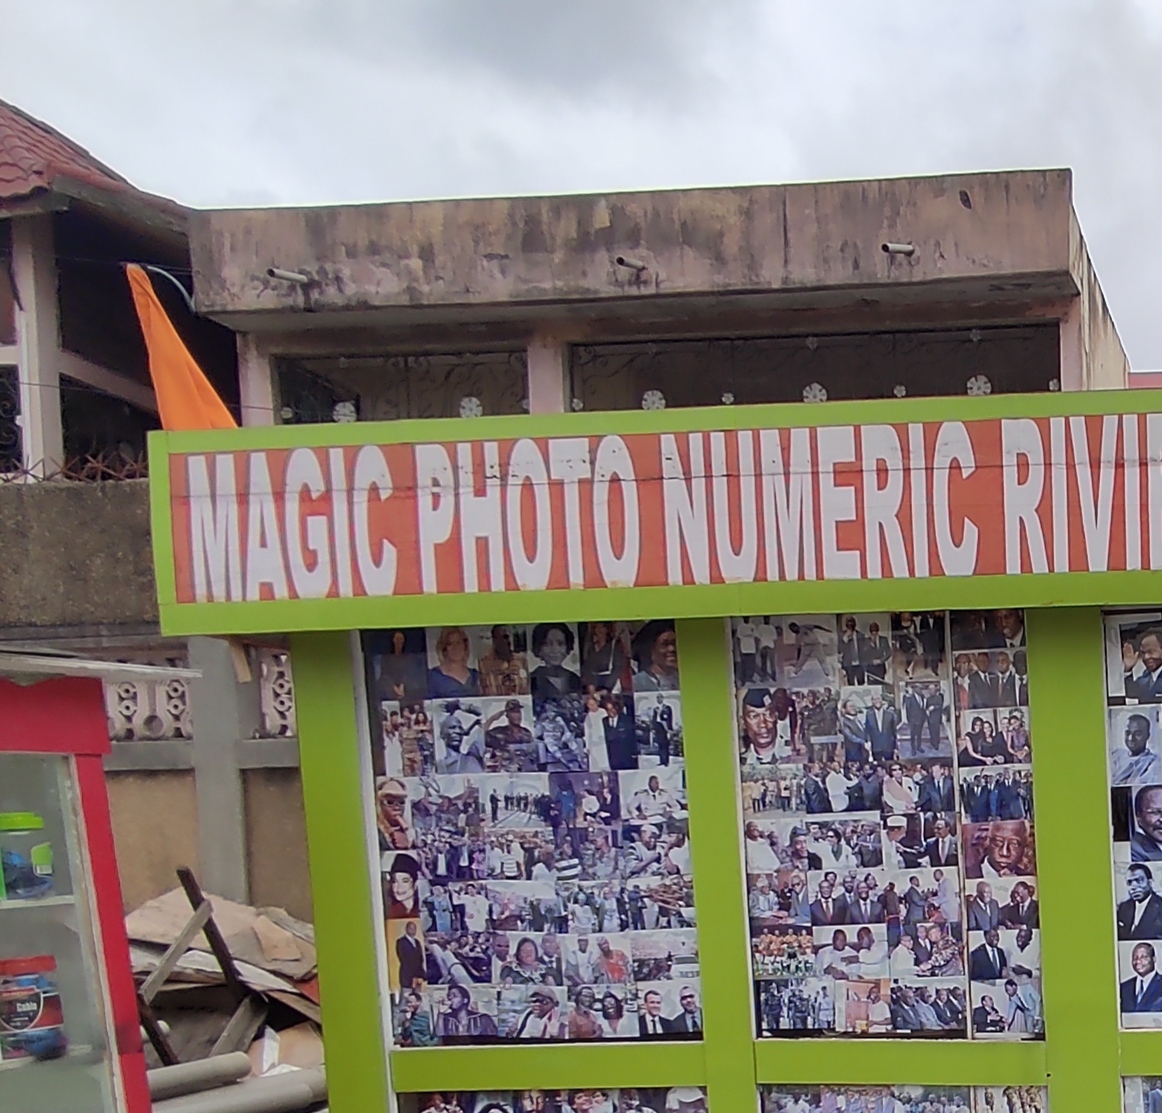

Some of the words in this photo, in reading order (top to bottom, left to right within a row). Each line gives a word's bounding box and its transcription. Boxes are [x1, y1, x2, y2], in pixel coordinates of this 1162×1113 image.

[187, 445, 397, 603] MAGIC
[414, 434, 639, 594] PHOTO
[660, 421, 979, 585] NUMERIC
